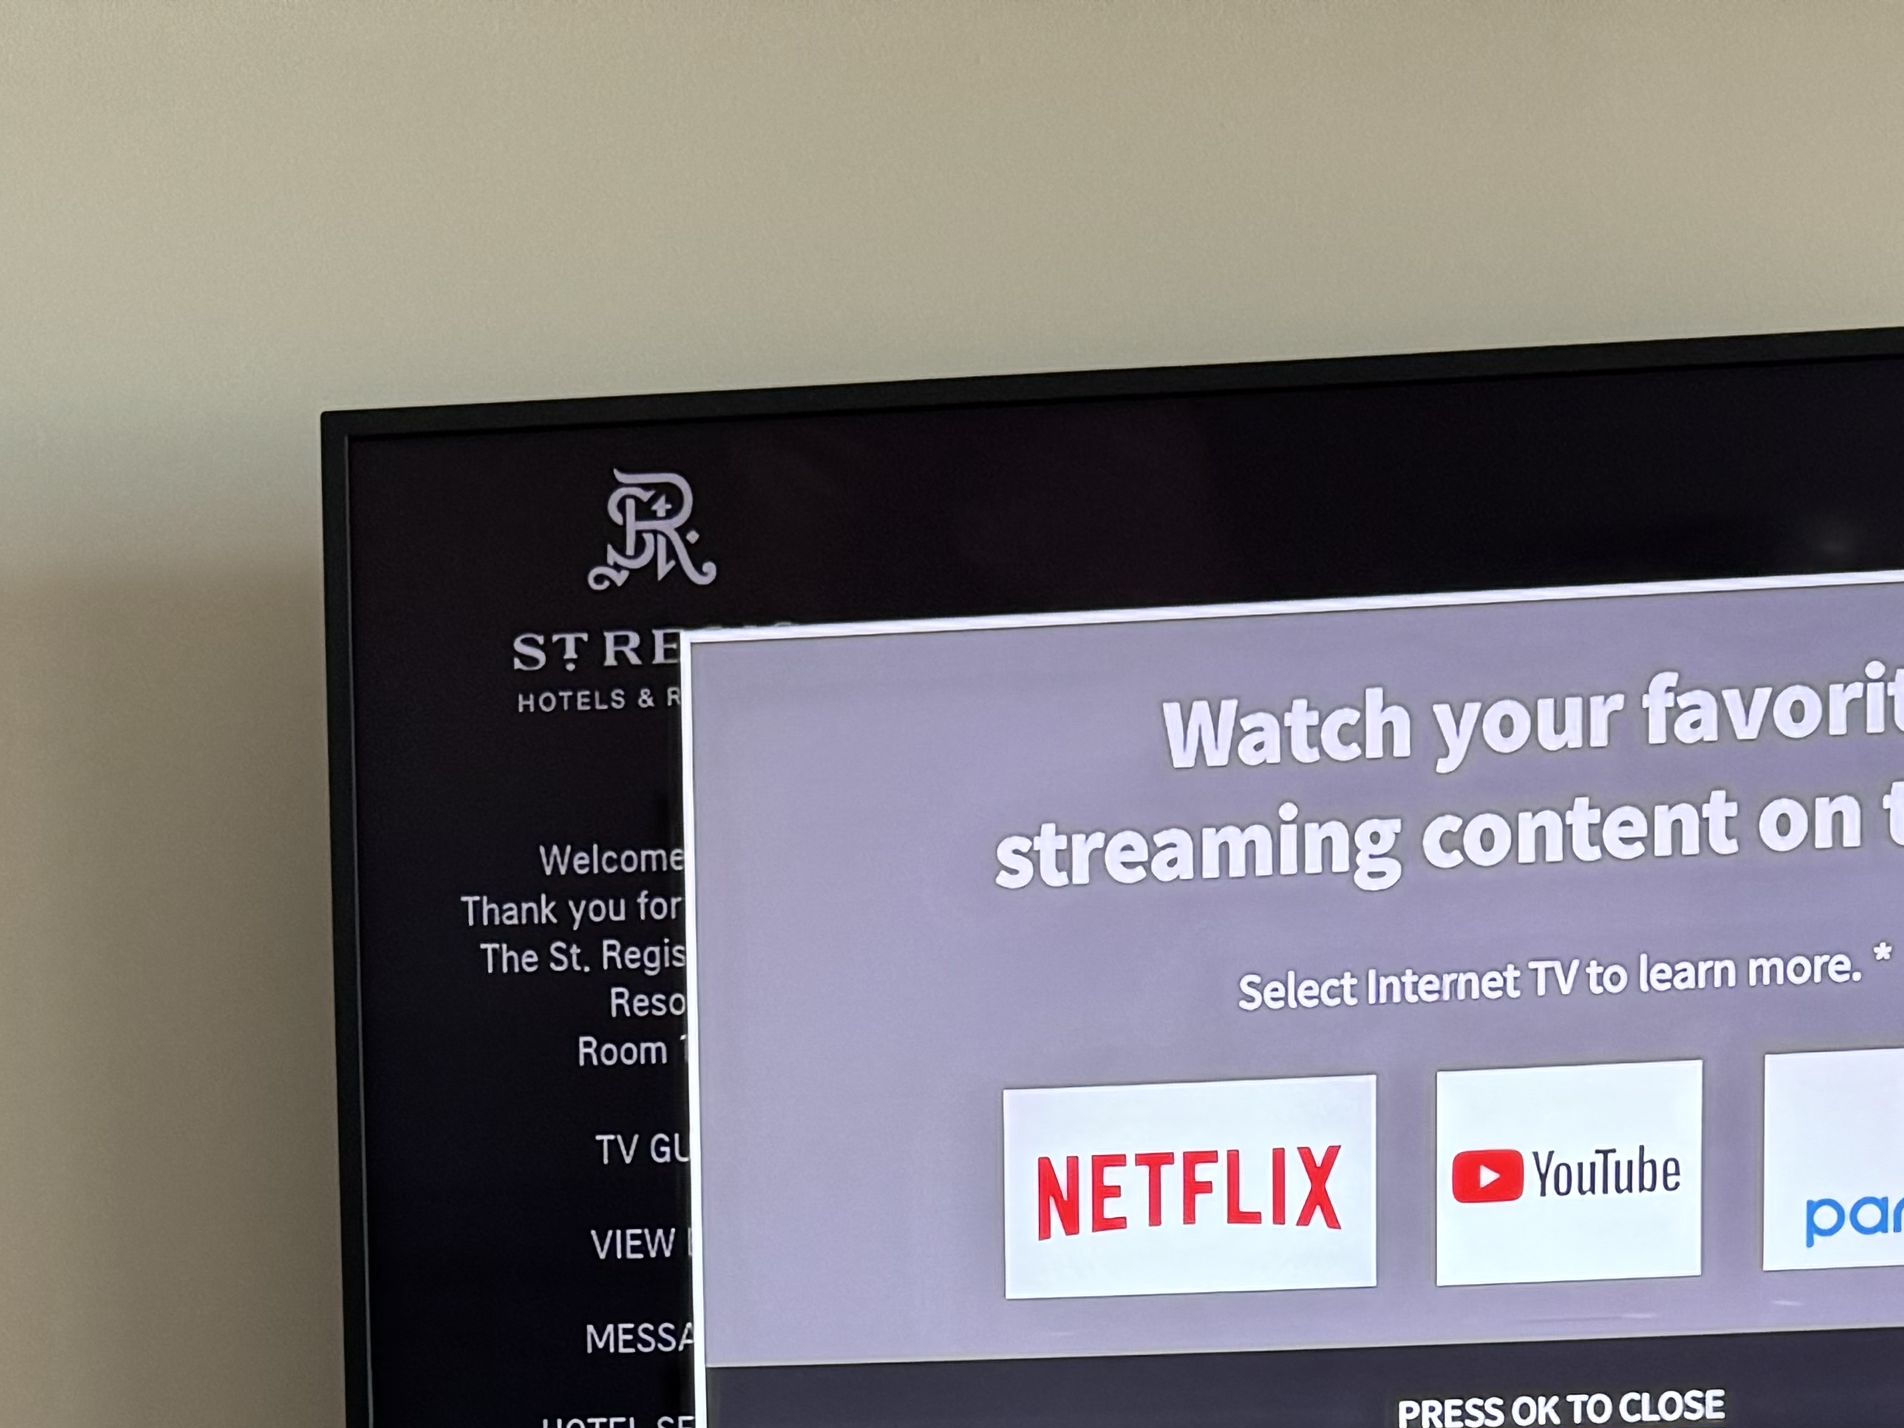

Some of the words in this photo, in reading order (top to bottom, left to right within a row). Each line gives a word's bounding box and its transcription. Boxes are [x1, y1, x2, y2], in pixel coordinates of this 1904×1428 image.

[518, 688, 626, 713] HOTELS
[637, 688, 655, 708] &
[1162, 687, 1411, 768] Watch
[1432, 693, 1625, 774] your
[539, 843, 684, 875] Welcome
[995, 802, 1402, 891] streaming
[1422, 790, 1739, 869] content
[1758, 794, 1861, 852] on
[460, 893, 558, 927] Thank
[568, 898, 626, 931] you
[636, 889, 683, 921] for
[479, 942, 539, 974] The
[549, 940, 591, 973] St.
[602, 938, 686, 976] Regis
[1238, 970, 1359, 1011] Select
[1368, 963, 1521, 1005] Internet
[1527, 958, 1580, 996] TV
[1585, 960, 1628, 995] to
[1639, 953, 1736, 993] learn
[578, 1035, 668, 1067] Room
[595, 1133, 639, 1165] TV
[1532, 1144, 1681, 1197] YouTube
[1038, 1146, 1341, 1240] NETFLIX
[590, 1227, 676, 1260] VIEW
[1511, 1395, 1561, 1427] OK
[1565, 1393, 1613, 1425] TO
[1618, 1389, 1726, 1423] CLOSE
